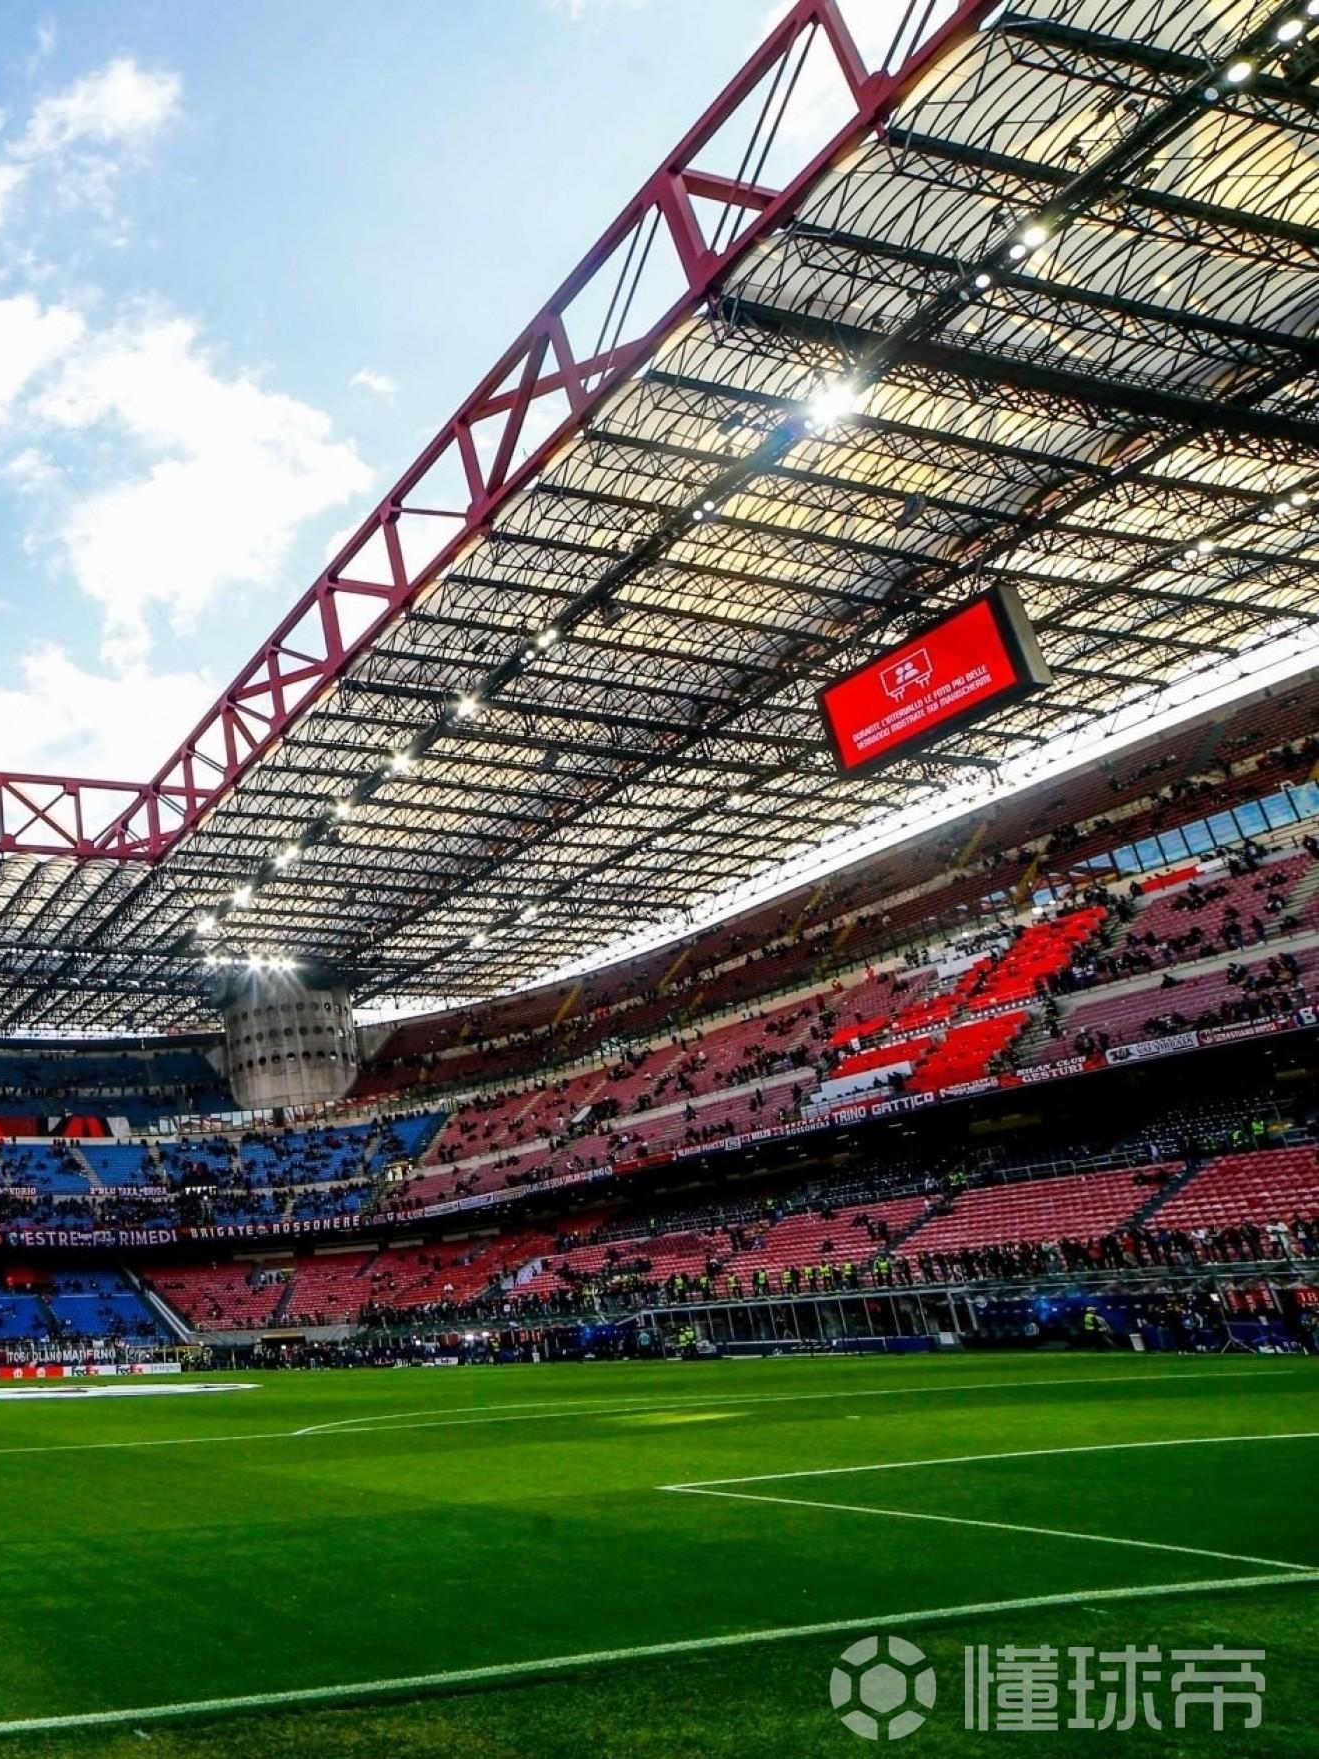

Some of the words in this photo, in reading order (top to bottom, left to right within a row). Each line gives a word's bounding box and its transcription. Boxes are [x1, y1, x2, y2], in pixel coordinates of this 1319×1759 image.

[1016, 1063, 1051, 1076] MILAN
[1022, 1063, 1085, 1083] GESTURI
[832, 1106, 867, 1125] TRINO
[871, 1091, 935, 1115] GATTICO
[191, 1225, 254, 1239] BRIGATE
[273, 1215, 360, 1234] ROSSONERE
[119, 1229, 179, 1247] RIMEDI
[72, 1366, 99, 1376] FedEx
[116, 1365, 143, 1375] FedEx
